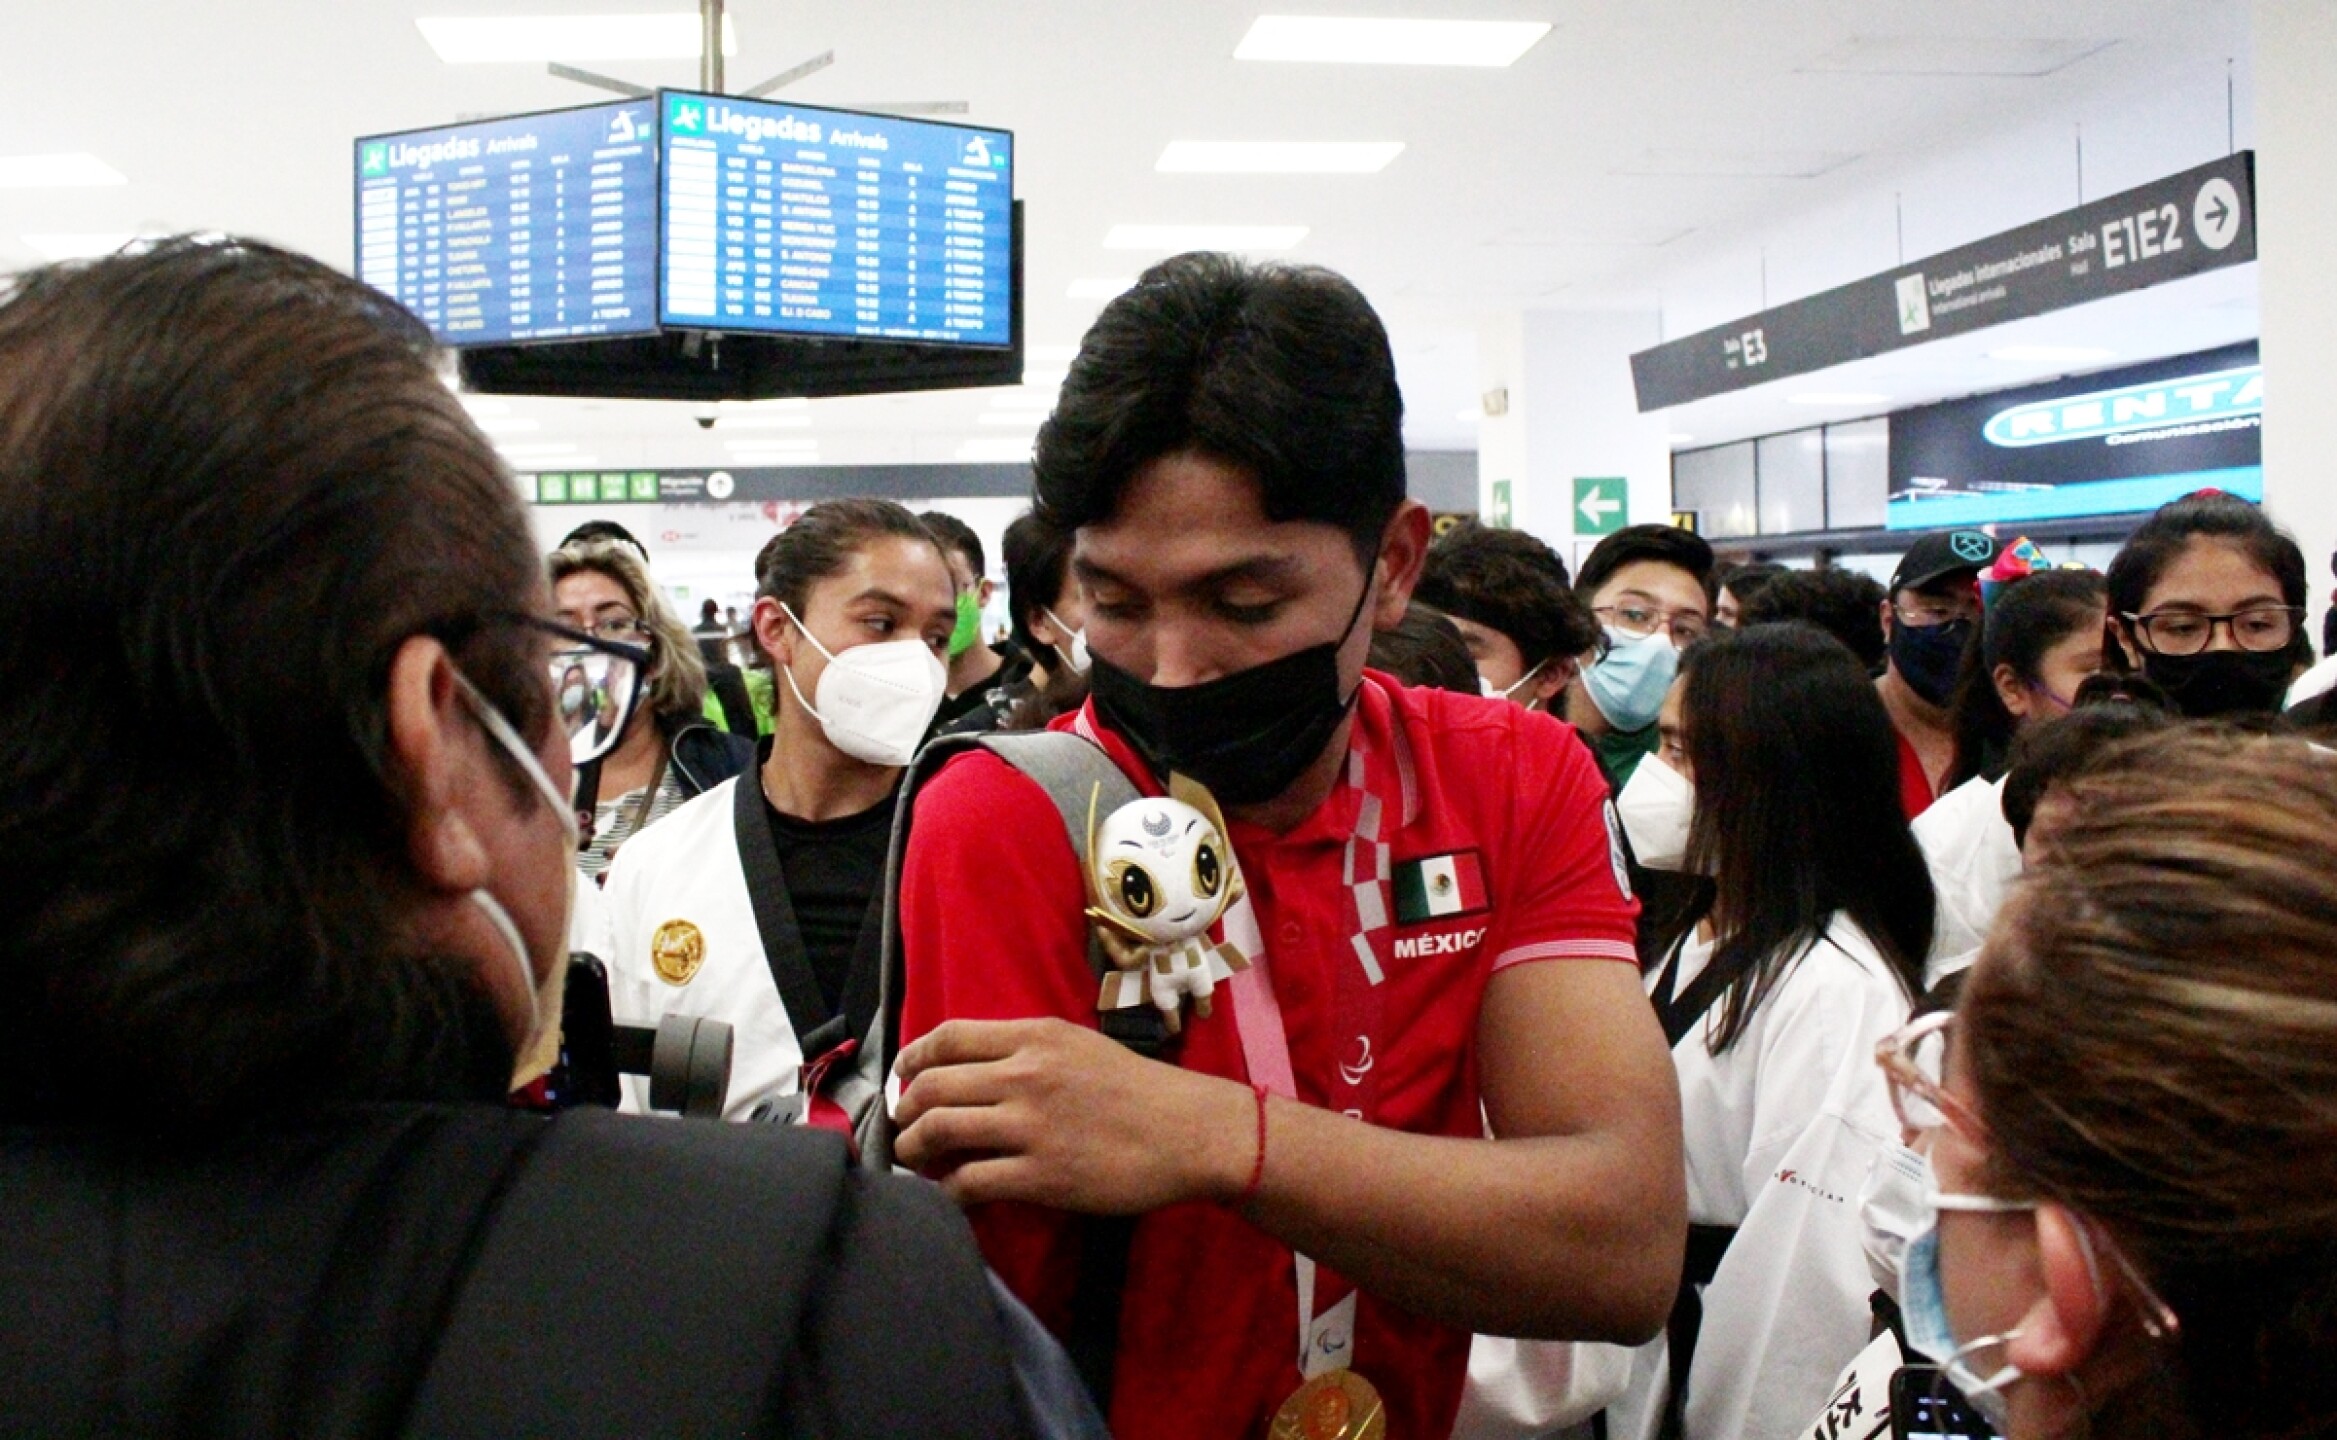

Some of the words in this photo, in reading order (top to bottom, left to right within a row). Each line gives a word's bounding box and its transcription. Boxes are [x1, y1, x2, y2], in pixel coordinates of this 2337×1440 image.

[706, 106, 822, 142] Llegadas
[388, 135, 480, 170] Llegadas
[2067, 231, 2097, 256] Sala
[1929, 270, 1974, 297] Llegadas
[1742, 328, 1768, 367] E3
